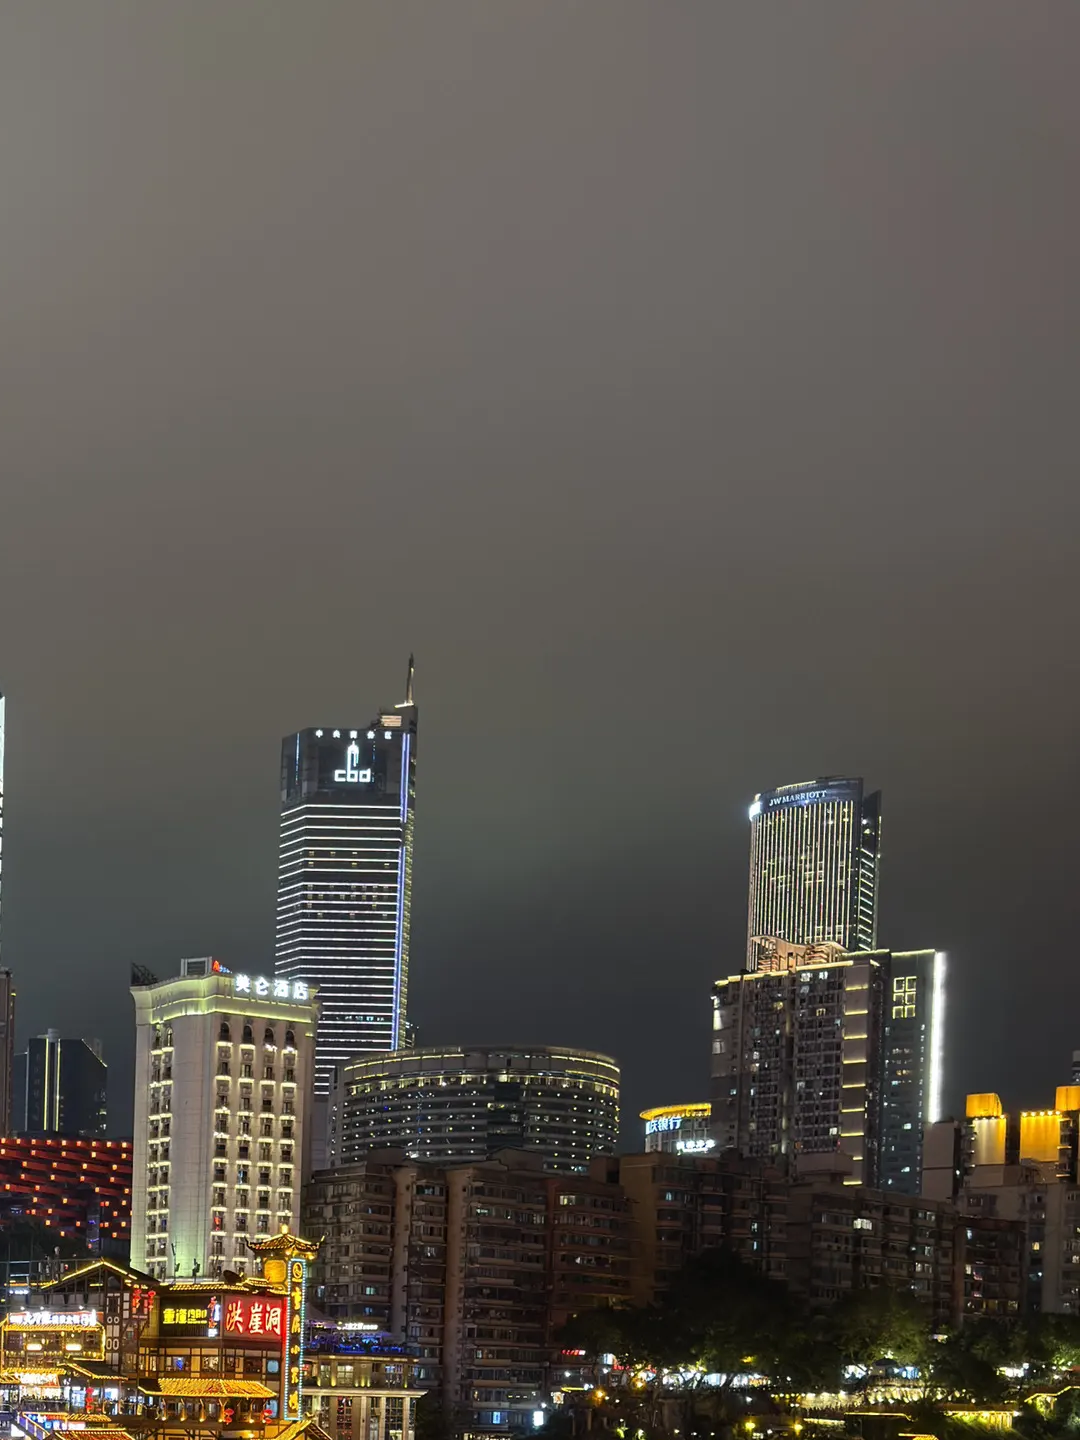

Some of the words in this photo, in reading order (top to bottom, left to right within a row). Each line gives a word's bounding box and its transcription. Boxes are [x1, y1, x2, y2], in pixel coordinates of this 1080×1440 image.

[235, 974, 309, 1000] 美仑酒店
[225, 1300, 281, 1336] 洪崖洞
